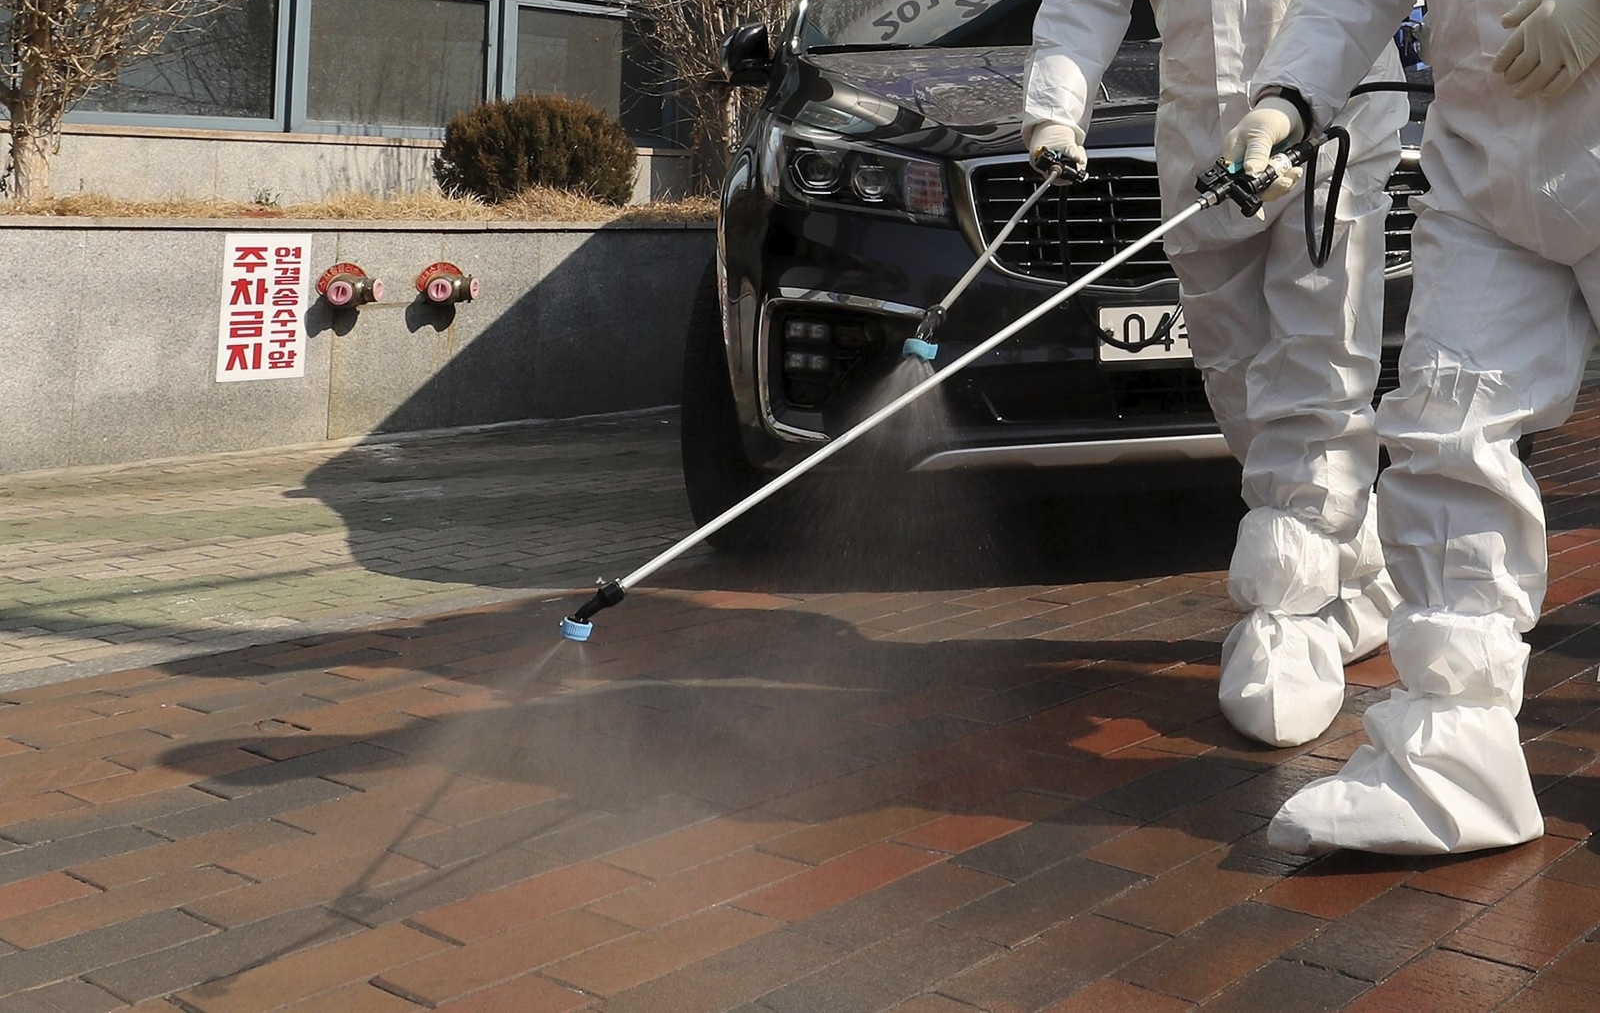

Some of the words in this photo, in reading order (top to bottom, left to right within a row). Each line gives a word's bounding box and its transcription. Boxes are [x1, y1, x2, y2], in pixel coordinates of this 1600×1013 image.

[225, 246, 269, 371] 주차금지
[268, 246, 302, 370] 연결송수구앞
[1123, 313, 1191, 354] 04
